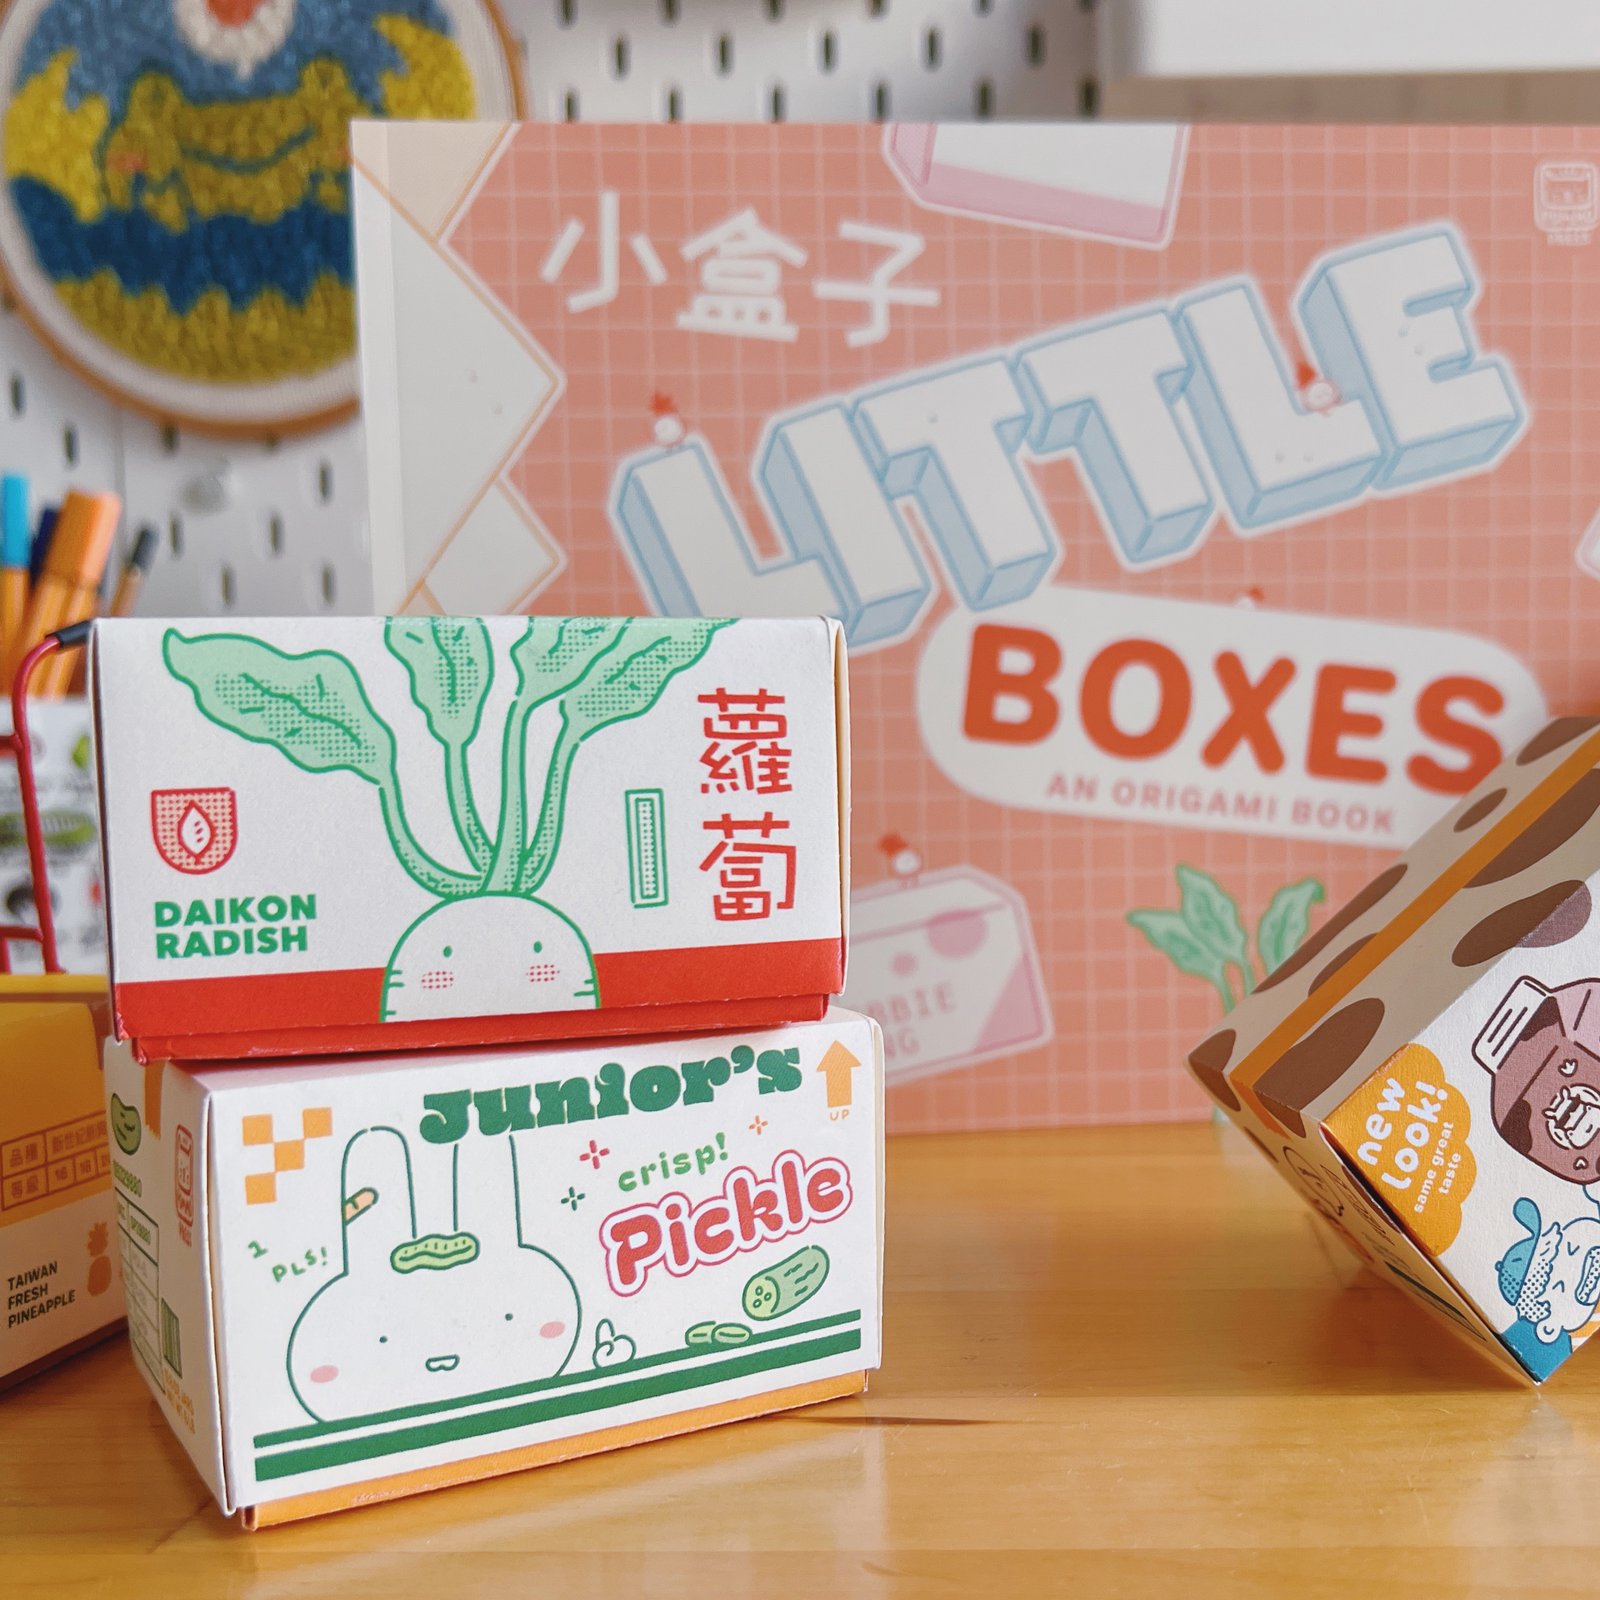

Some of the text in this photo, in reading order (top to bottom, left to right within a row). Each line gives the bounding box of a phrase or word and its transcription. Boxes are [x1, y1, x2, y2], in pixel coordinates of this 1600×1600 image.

[540, 189, 940, 346] 小盒子
[614, 230, 1521, 648] LITTLE
[962, 623, 1506, 796] BOXES
[698, 688, 796, 921] 蘿蔔
[1045, 774, 1394, 833] AN ORIGAMI BOOK
[154, 894, 317, 928] DAIKON
[156, 925, 309, 959] RADISH
[419, 1045, 802, 1144] Junior's
[829, 1109, 850, 1121] UP
[1357, 1078, 1405, 1166] new
[618, 1132, 728, 1192] crisp!
[1381, 1081, 1448, 1190] look!
[1414, 1121, 1454, 1213] same great
[1438, 1152, 1462, 1195] taste
[606, 1156, 848, 1290] Pickle
[8, 1261, 58, 1291] TAIWAN
[271, 1246, 328, 1282] PLS!
[8, 1283, 48, 1310] FRESH
[8, 1289, 76, 1328] PINEAPPLE
